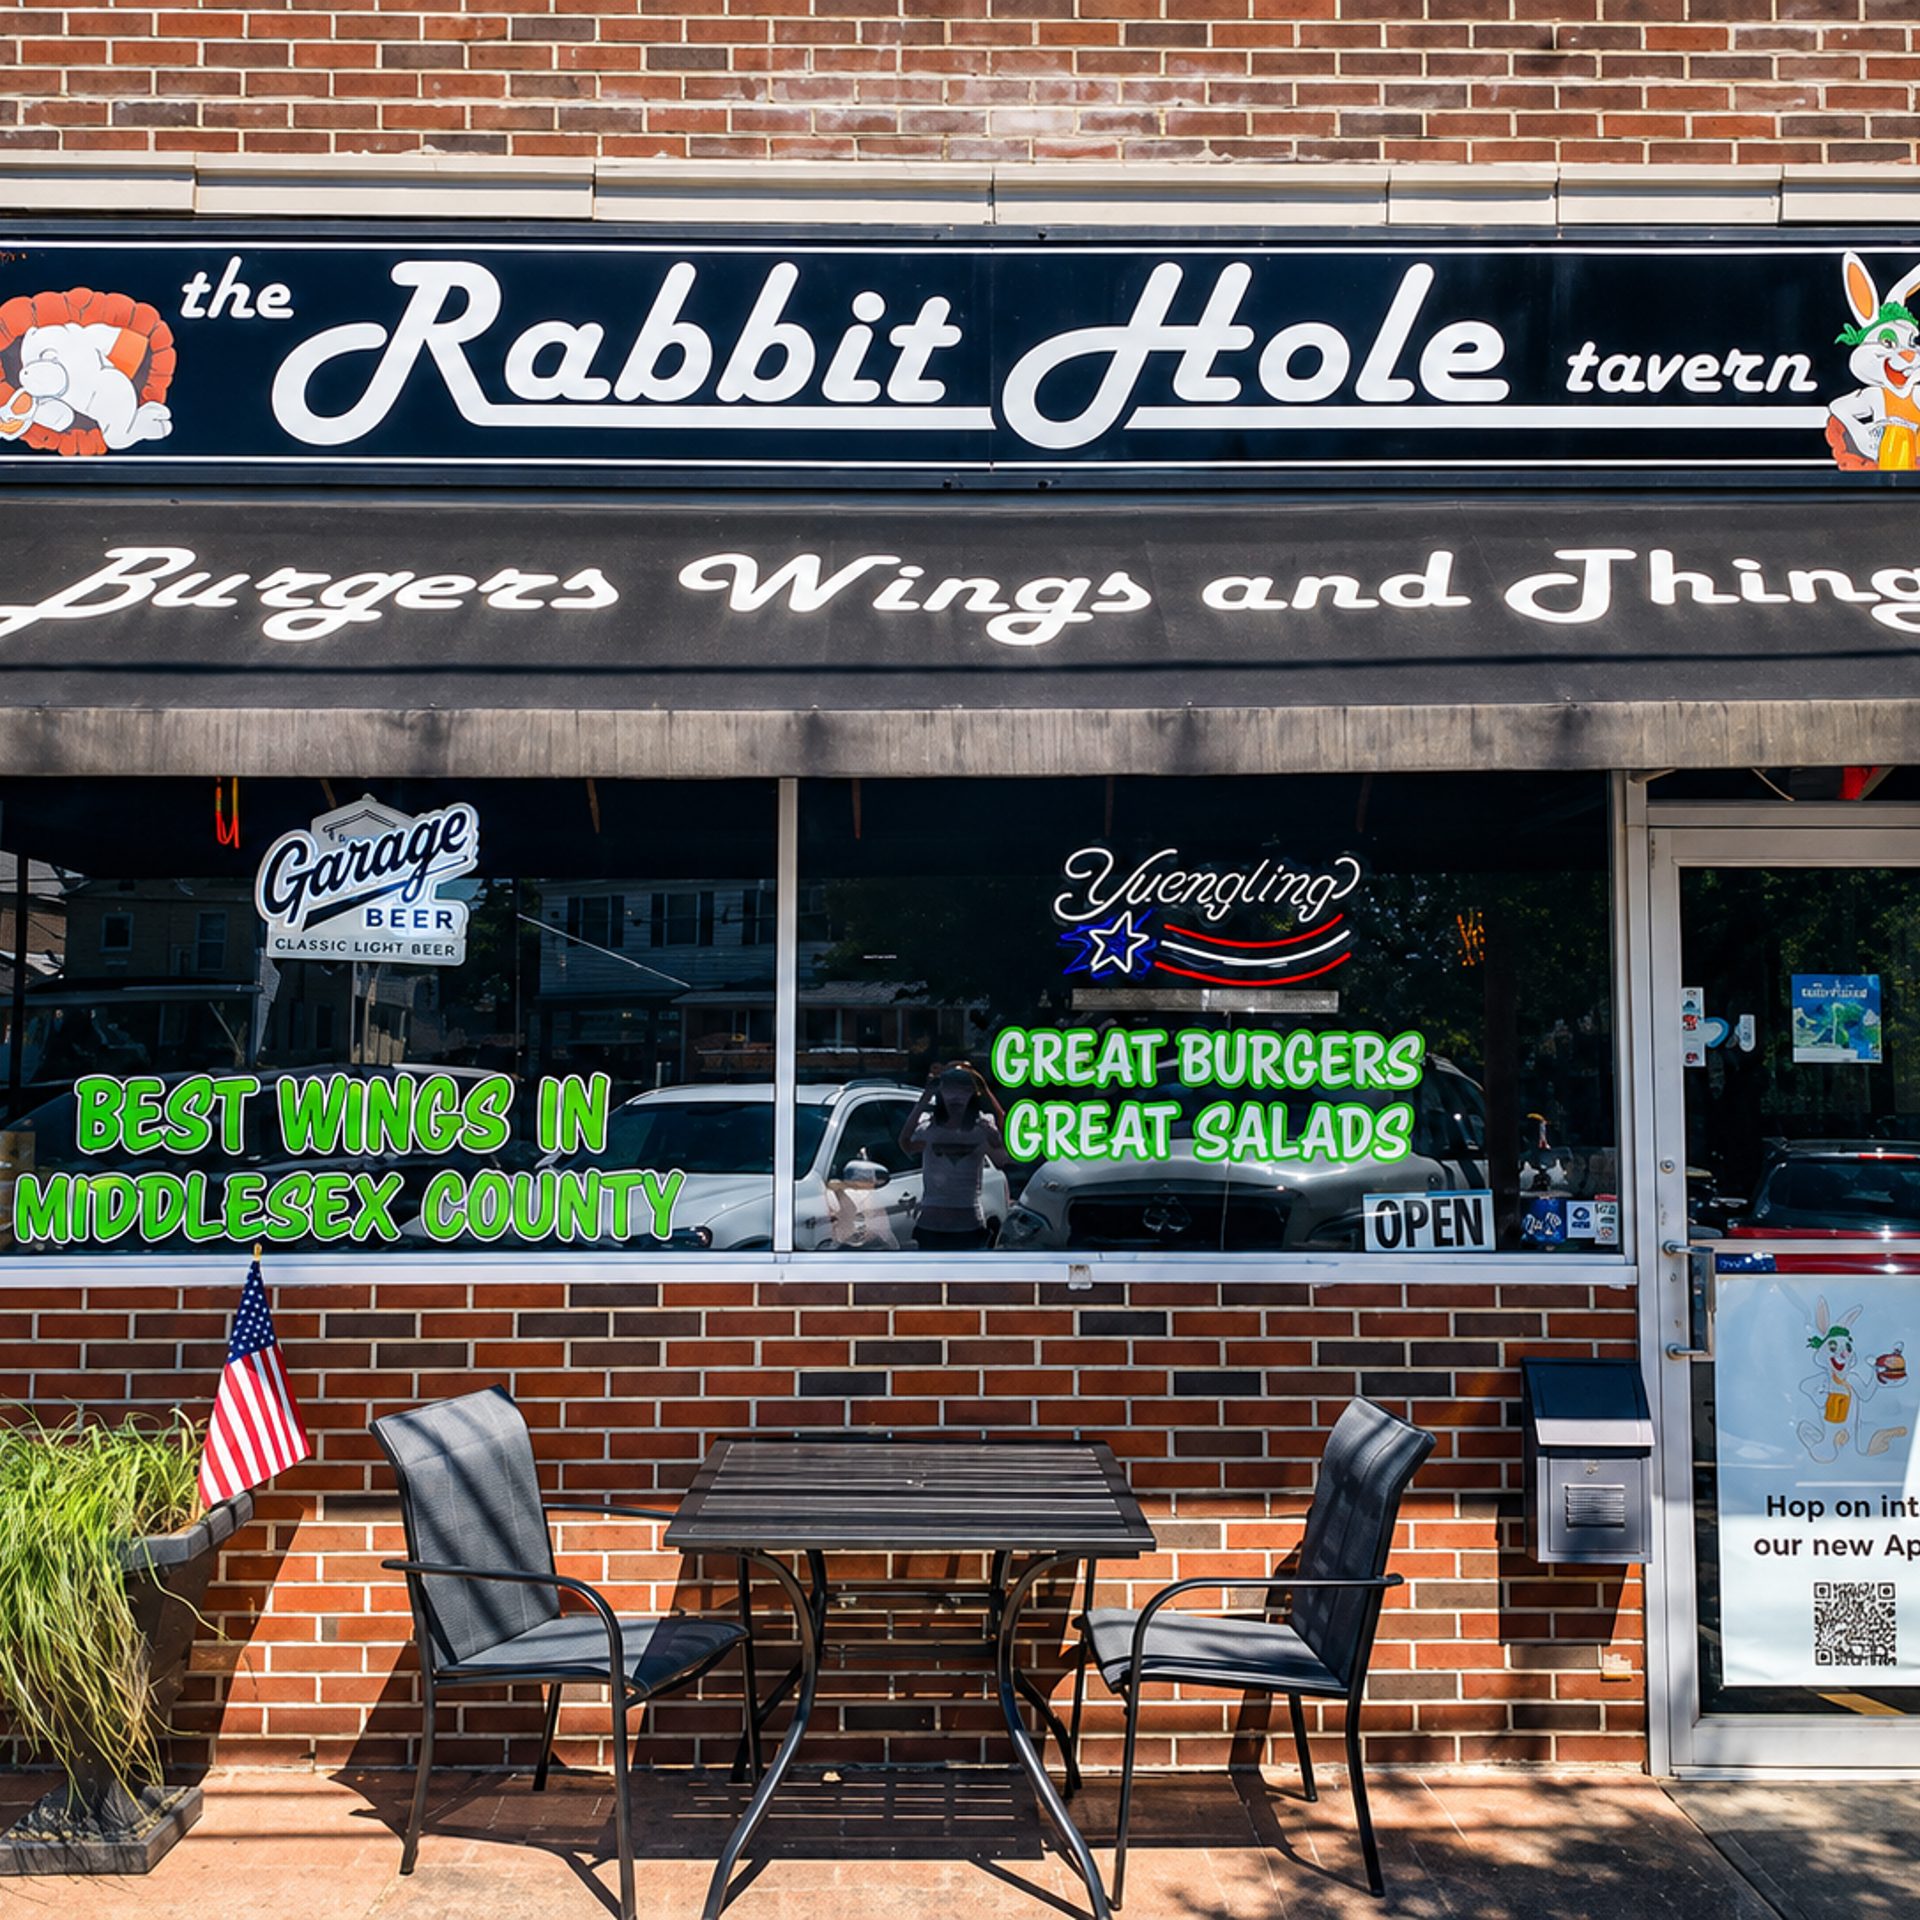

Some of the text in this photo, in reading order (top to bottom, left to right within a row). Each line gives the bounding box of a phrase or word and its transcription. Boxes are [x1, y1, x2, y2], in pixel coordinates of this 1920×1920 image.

[181, 256, 1818, 449] the Rabbit Hole tavern
[0, 547, 619, 641] Burgers
[678, 553, 1151, 646] Wings
[1202, 551, 1471, 610] and
[264, 810, 468, 924] Garage
[1054, 848, 1360, 922] Yuengling
[275, 938, 456, 957] CLASSIC LIGHT BEER
[365, 907, 454, 930] BEER
[992, 1026, 1425, 1090] GREAT BURGERS
[75, 1073, 610, 1154] BEST WINGS IN
[1004, 1099, 1414, 1163] GREAT SALADS
[15, 1169, 686, 1243] MIDDLESEX COUNTY
[1375, 1198, 1485, 1249] OPEN
[1766, 1495, 1825, 1523] Hop
[1835, 1500, 1871, 1518] on
[1754, 1538, 1803, 1556] our
[1812, 1538, 1874, 1556] new
